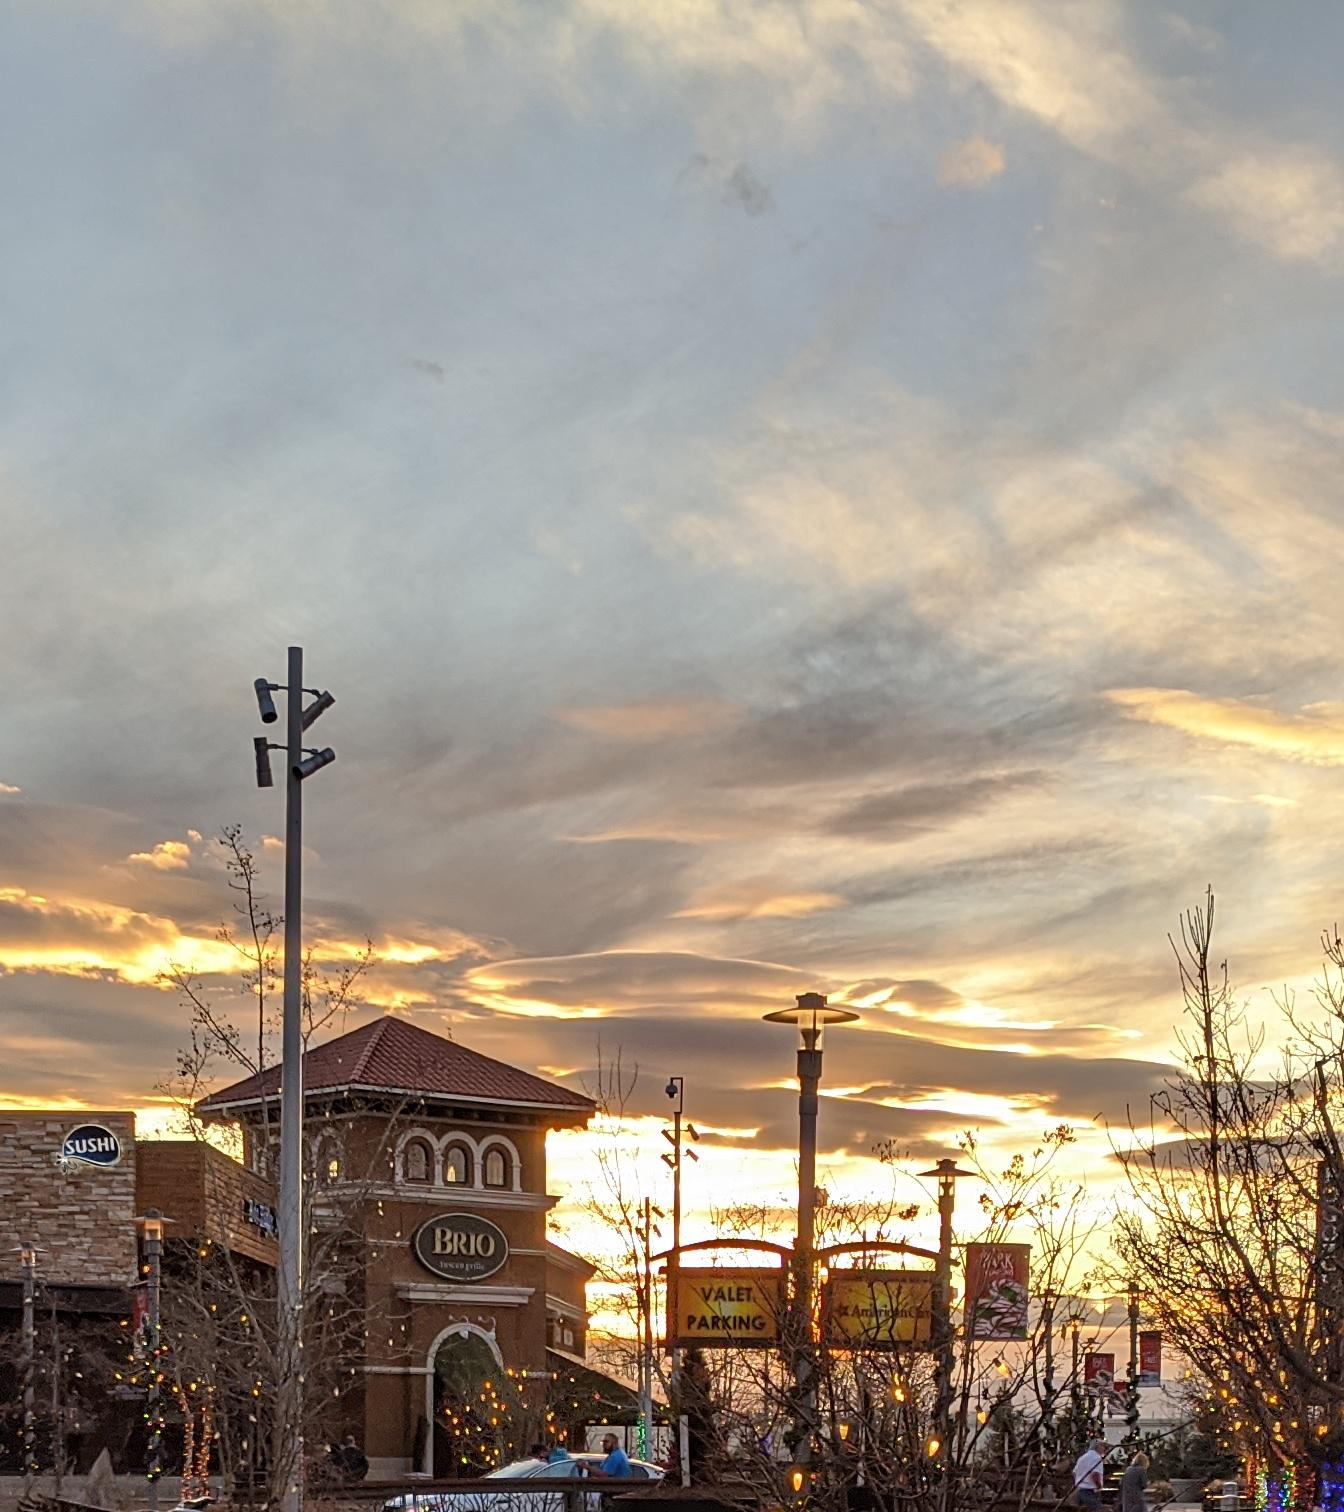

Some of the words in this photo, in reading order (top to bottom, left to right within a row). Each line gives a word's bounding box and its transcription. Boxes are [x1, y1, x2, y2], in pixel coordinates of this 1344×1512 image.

[65, 1136, 115, 1154] SUSHI
[432, 1227, 495, 1257] BRIO
[701, 1286, 753, 1302] VALET
[687, 1315, 766, 1331] PARKING
